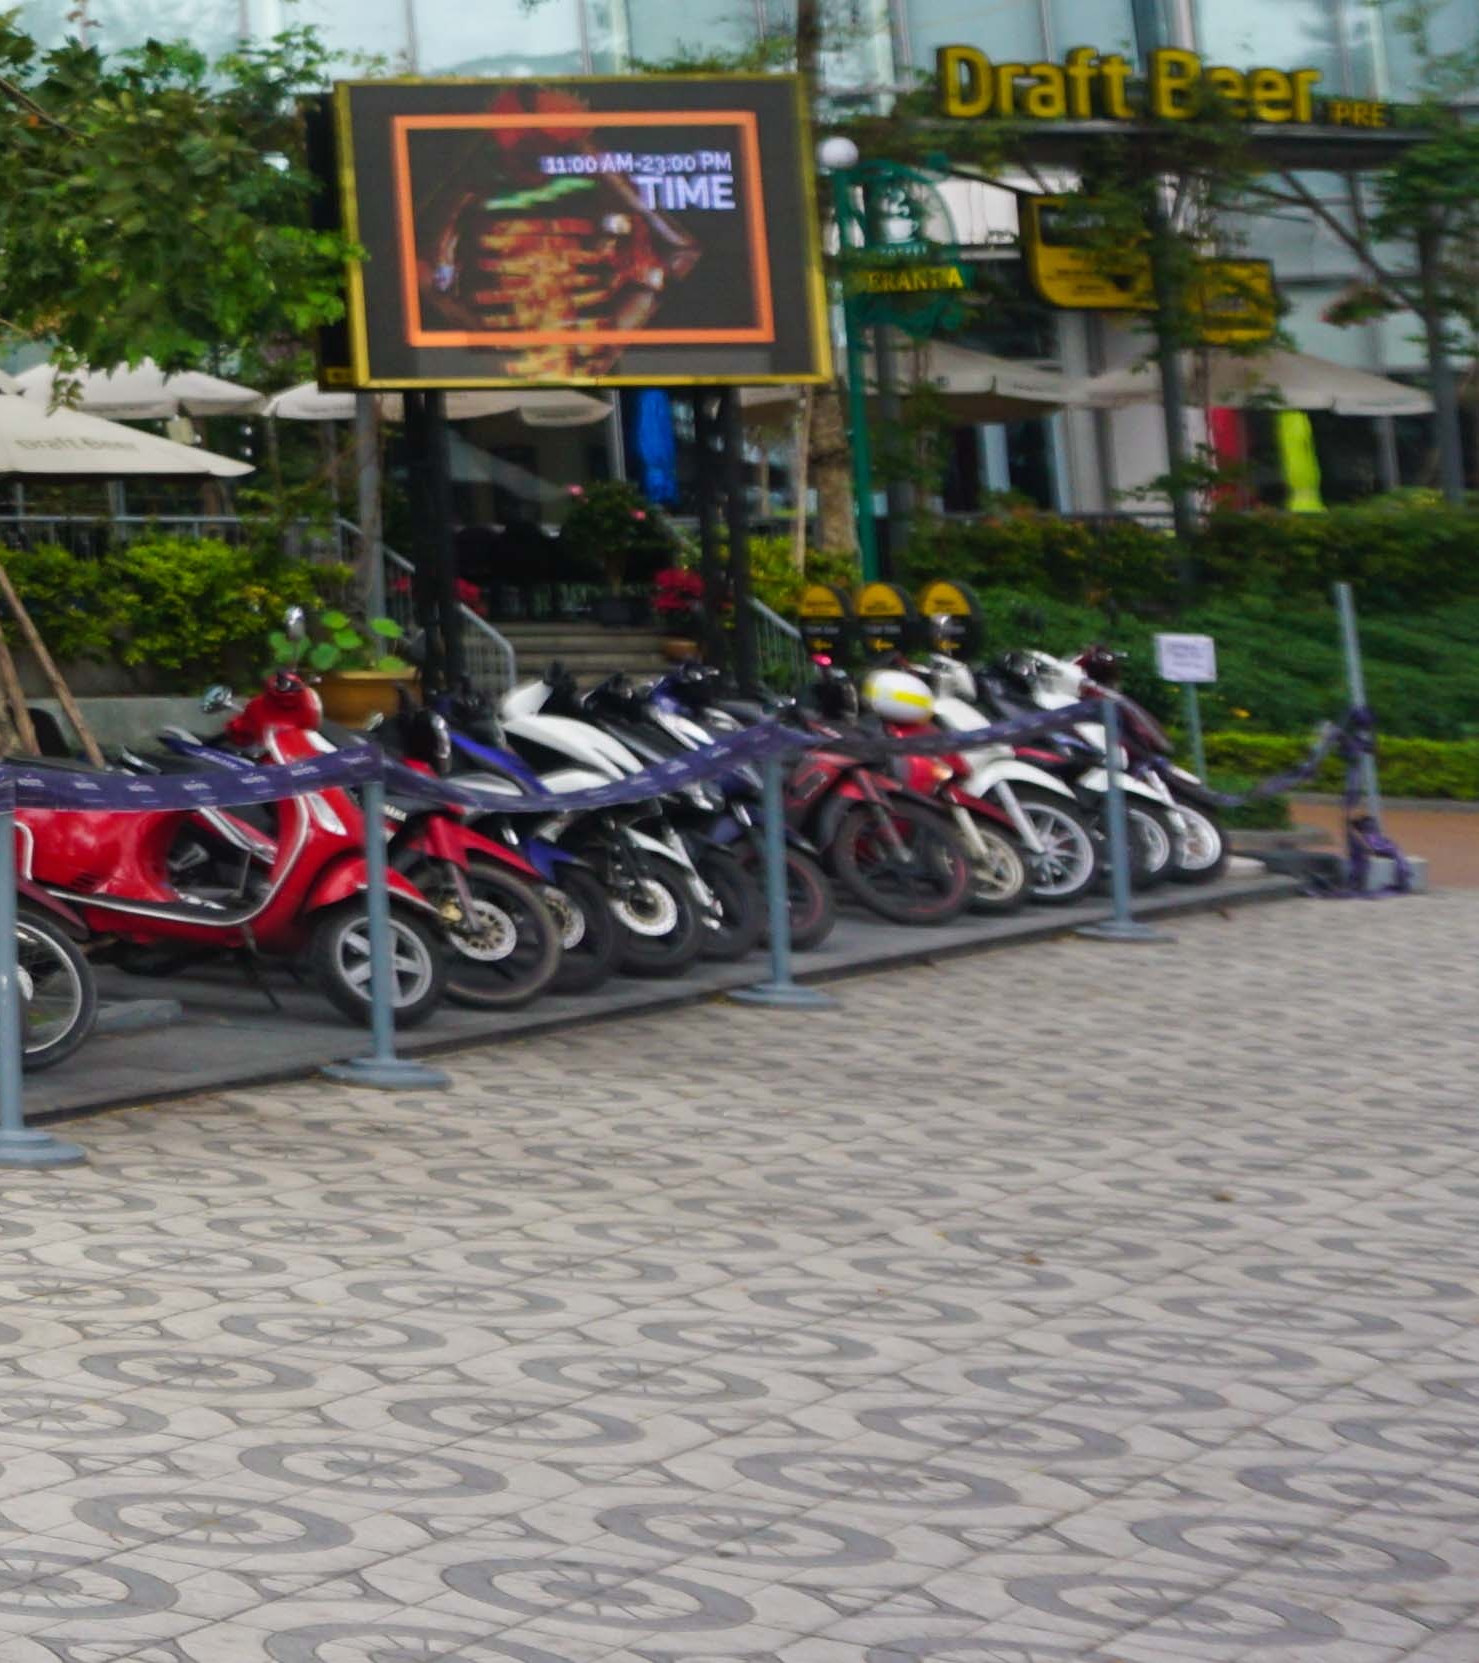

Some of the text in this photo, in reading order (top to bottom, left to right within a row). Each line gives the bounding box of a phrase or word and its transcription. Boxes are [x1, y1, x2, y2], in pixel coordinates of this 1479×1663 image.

[938, 44, 1135, 120] Draft
[1149, 47, 1321, 124] Beer
[700, 150, 733, 172] PM
[635, 175, 737, 210] TIME
